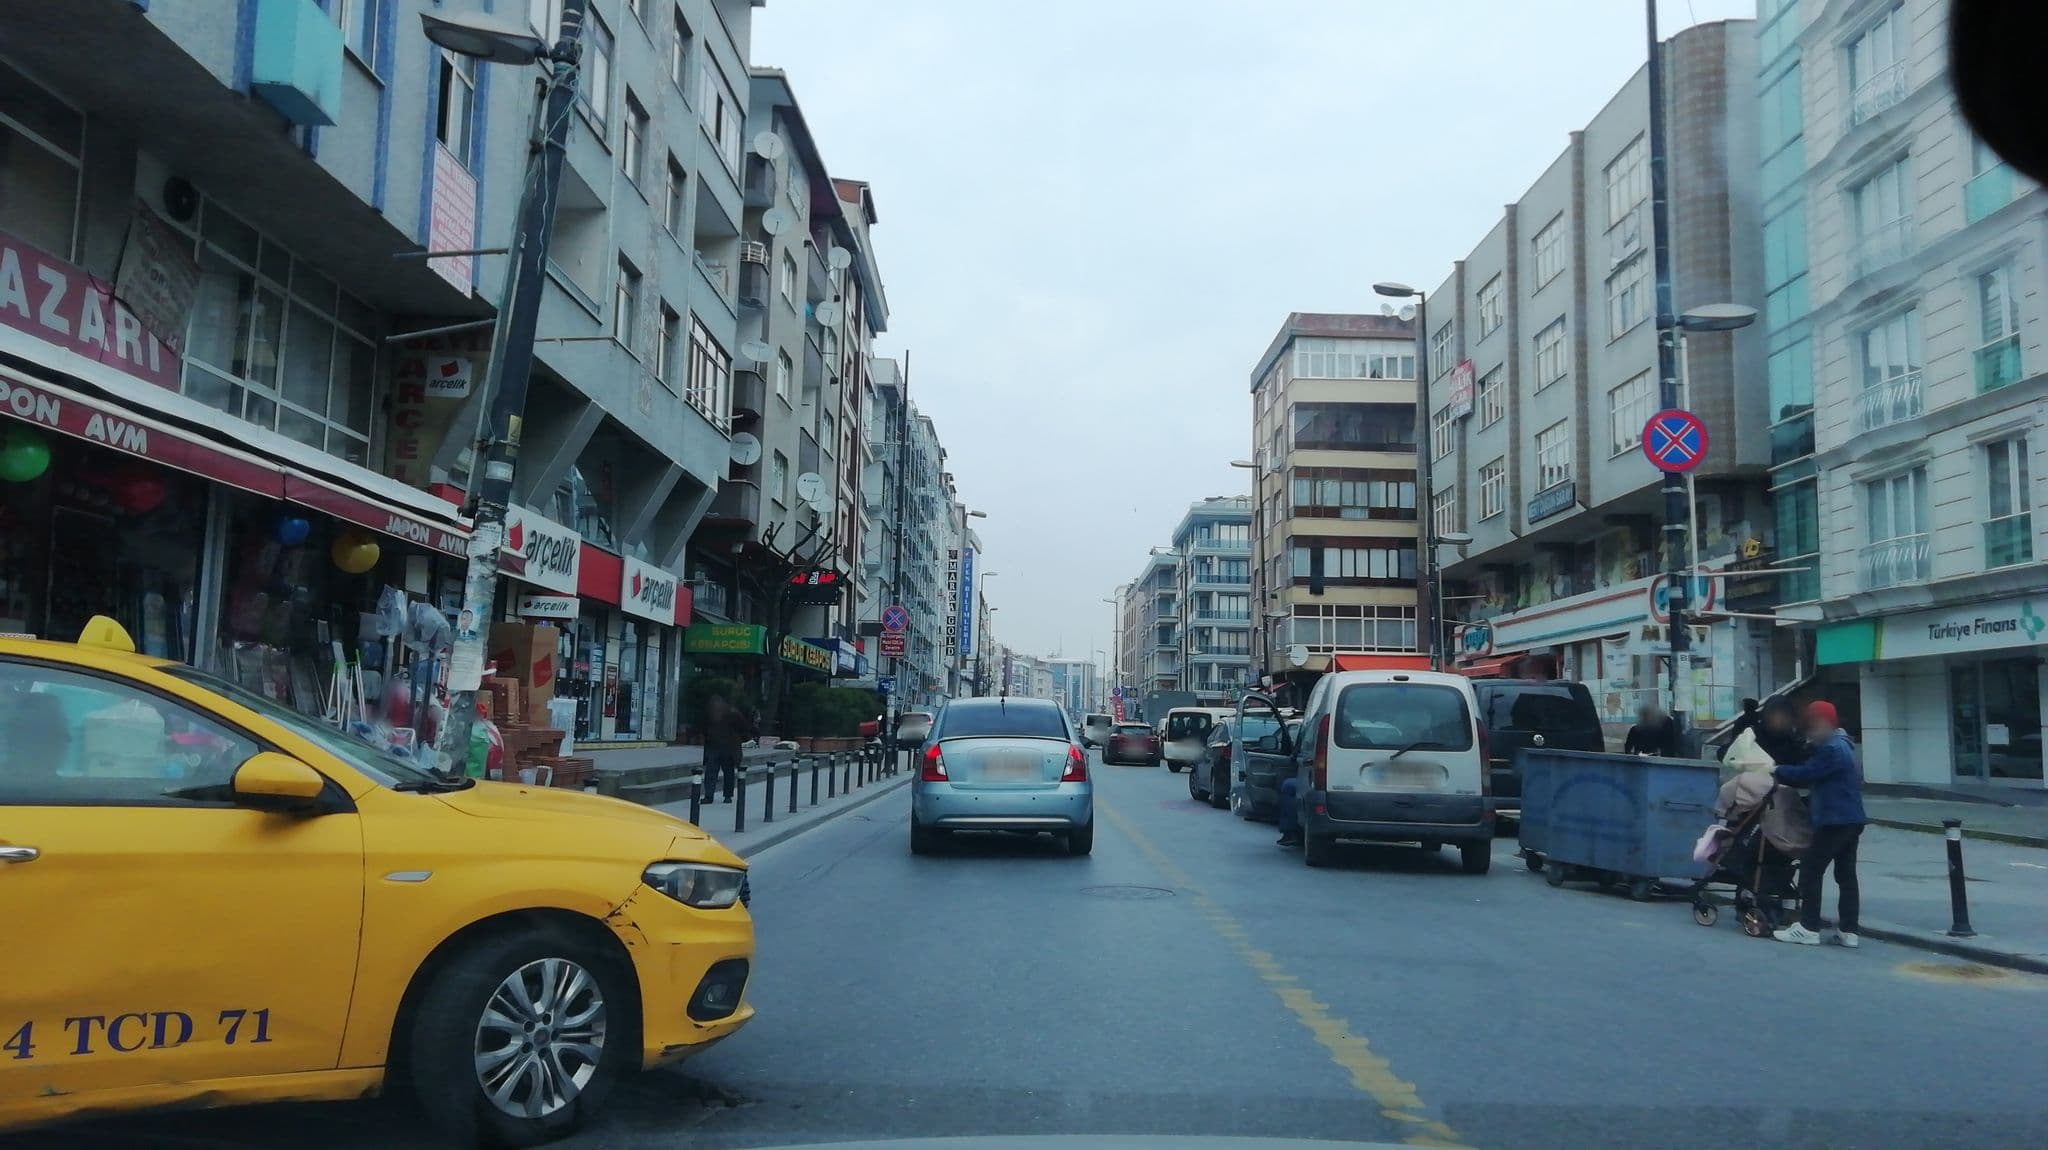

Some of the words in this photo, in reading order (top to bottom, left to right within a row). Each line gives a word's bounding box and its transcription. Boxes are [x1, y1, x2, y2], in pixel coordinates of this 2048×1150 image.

[429, 376, 467, 392] arçelik
[85, 413, 148, 454] AVM
[385, 514, 430, 545] JAPON
[438, 532, 466, 556] AVM
[525, 529, 577, 577] arçelik
[533, 601, 570, 614] arçelik
[640, 576, 675, 613] arçelik
[946, 616, 956, 656] GOLD
[1928, 622, 1971, 641] Türkiye
[1974, 617, 2017, 635] Finans
[64, 1011, 193, 1056] TCD
[218, 1008, 272, 1045] 71
